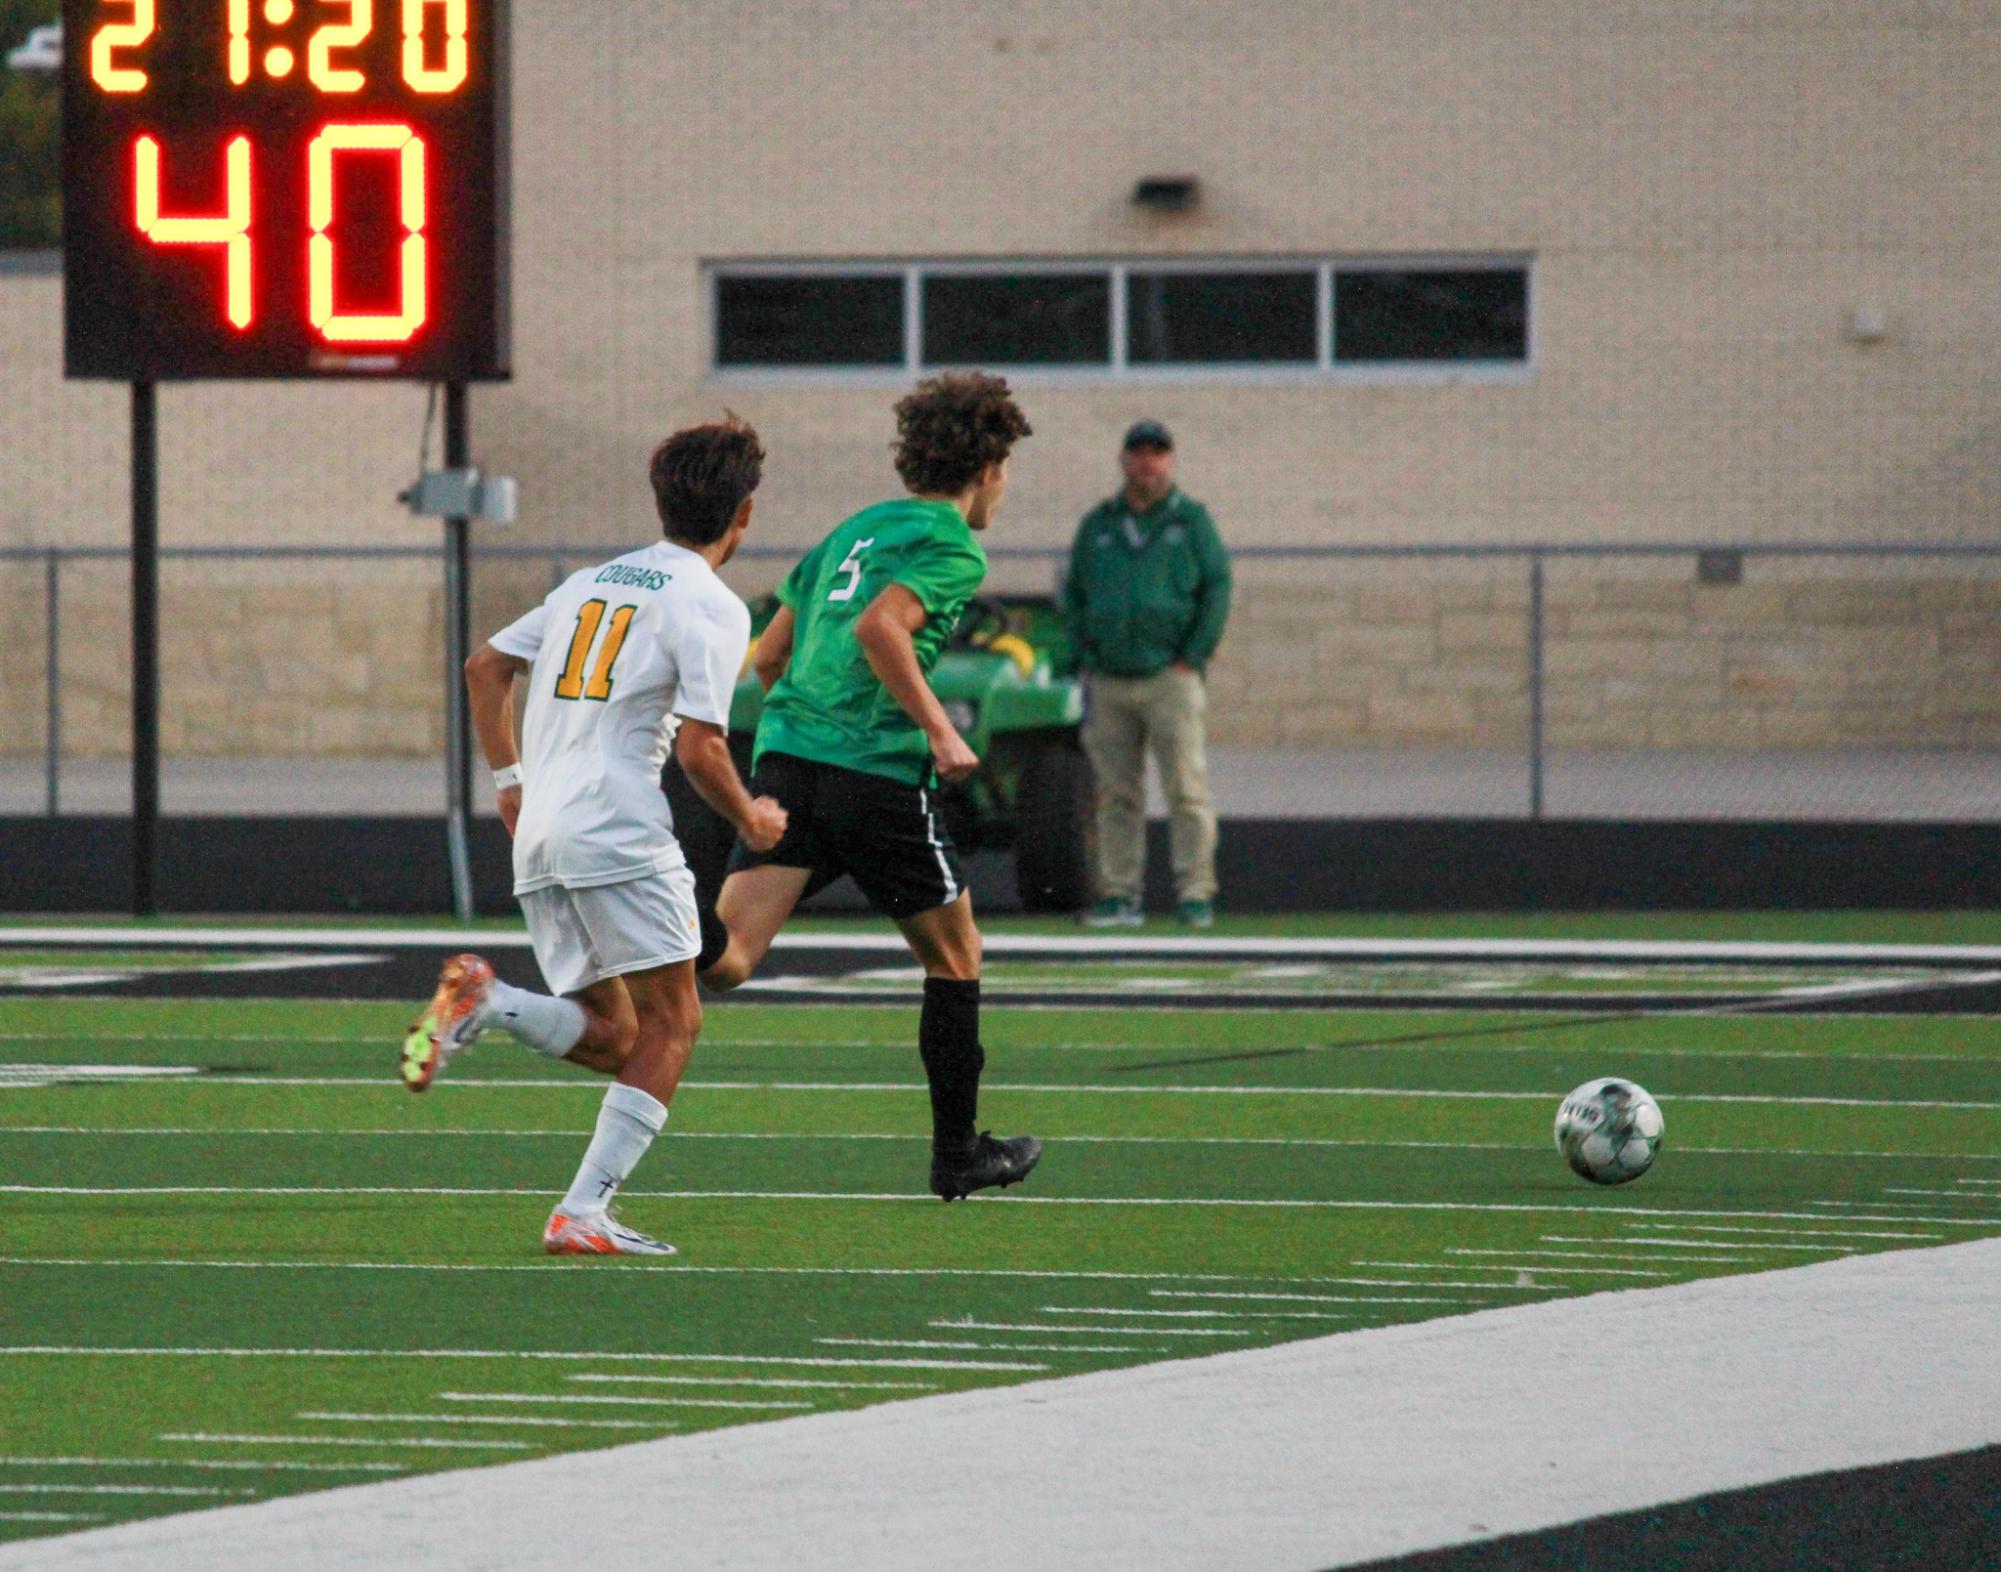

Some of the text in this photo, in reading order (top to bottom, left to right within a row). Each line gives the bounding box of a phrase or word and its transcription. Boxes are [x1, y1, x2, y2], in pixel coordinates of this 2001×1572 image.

[91, 0, 467, 92] 21:20
[136, 124, 426, 341] 40
[595, 564, 673, 591] COUGARS
[827, 537, 875, 601] 5
[554, 598, 639, 702] 11
